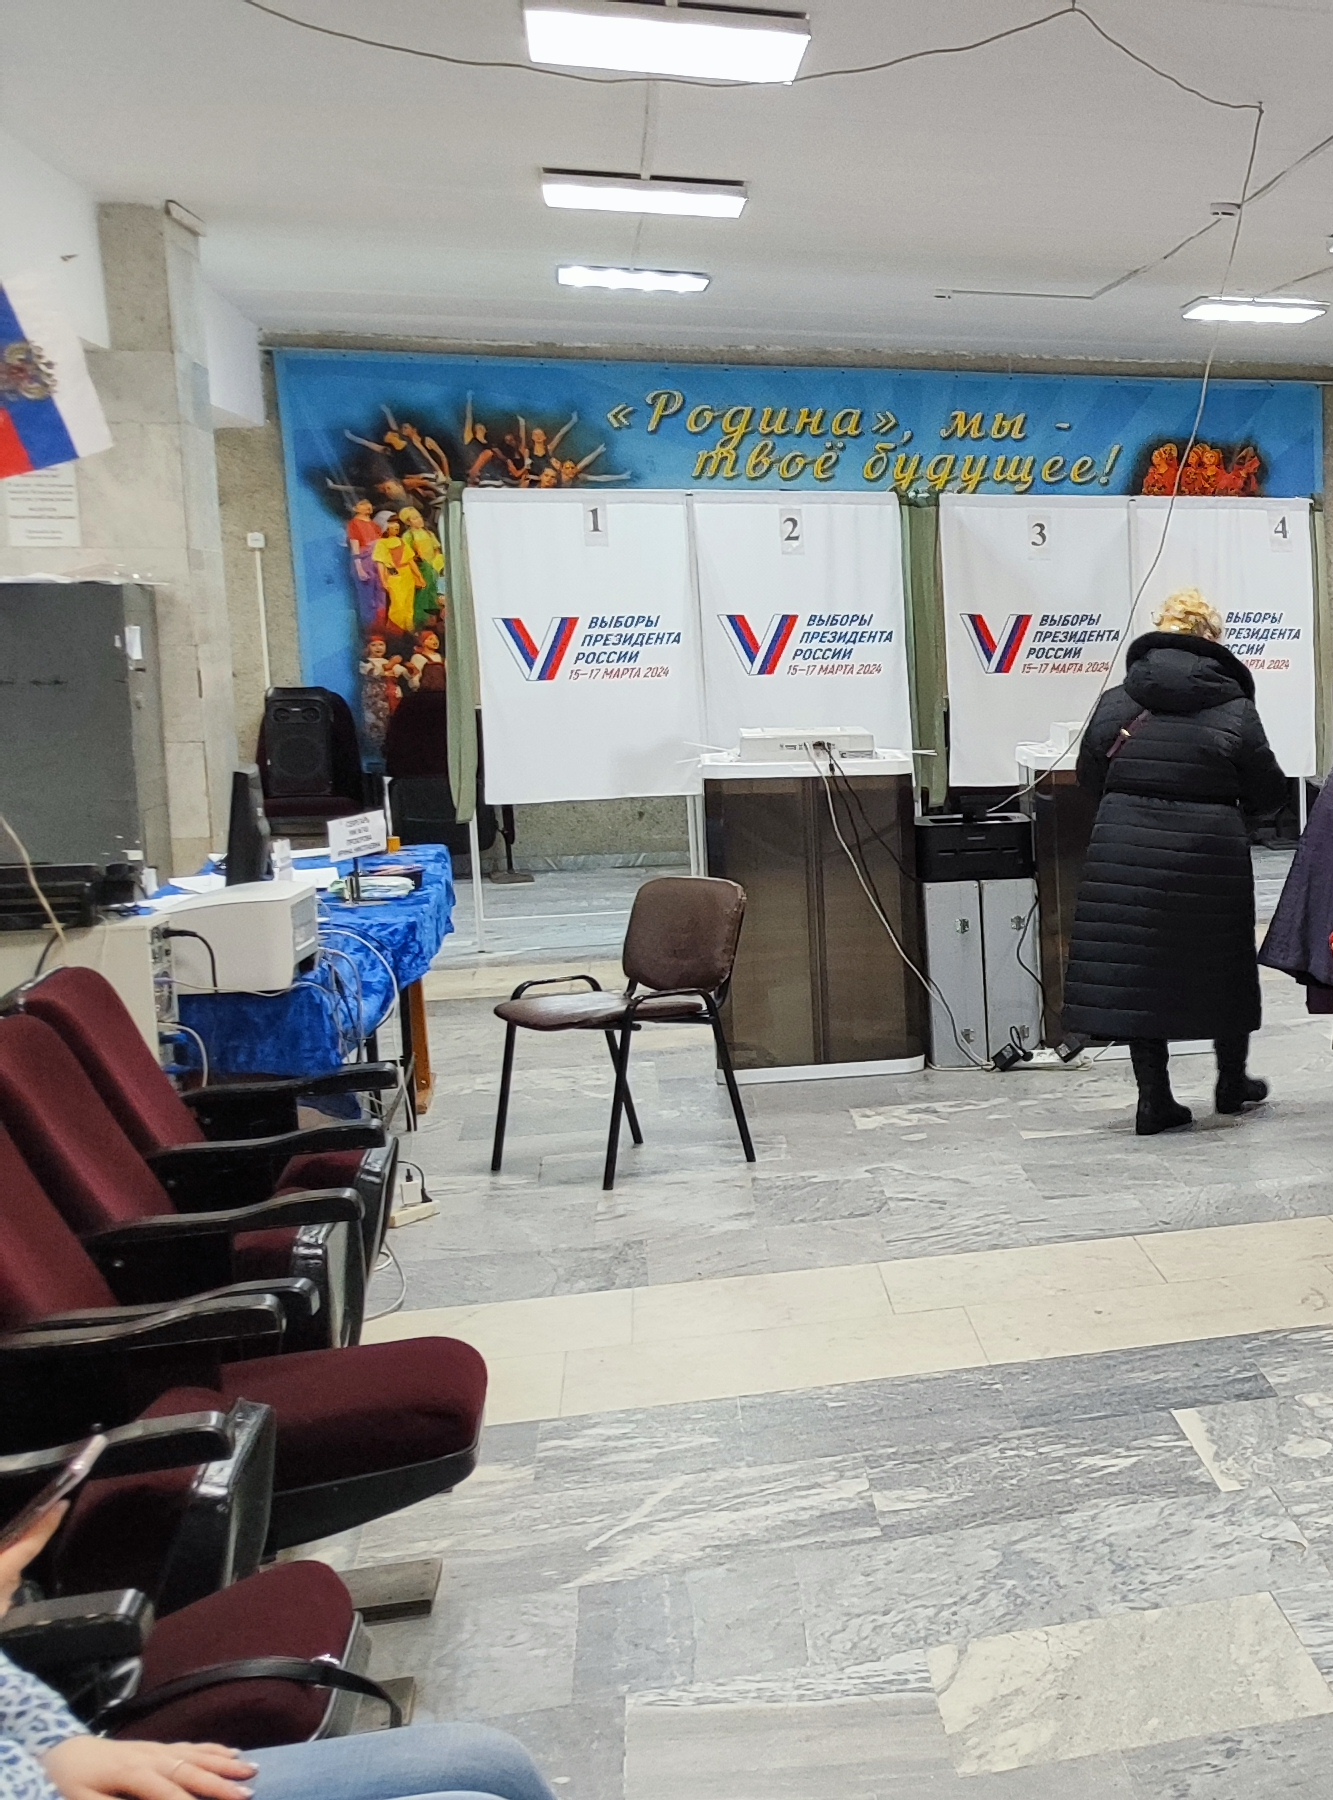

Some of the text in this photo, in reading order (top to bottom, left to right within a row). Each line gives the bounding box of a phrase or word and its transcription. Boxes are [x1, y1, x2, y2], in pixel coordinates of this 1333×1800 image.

[940, 409, 1029, 441] мы
[692, 440, 1124, 492] твоё будущее!
[587, 507, 603, 533] 1
[782, 517, 801, 542] 2
[1031, 522, 1047, 547] 3
[1273, 516, 1290, 539] 4
[587, 615, 661, 630] ВЫБОРЫ
[806, 614, 874, 627] ВЫБОРЫ
[1039, 613, 1102, 627] ВЫБОРЫ
[1225, 611, 1284, 625] ВЫБОРЫ
[581, 632, 682, 648] ПРЕЗИДЕНТА
[799, 630, 894, 645] ПРЕЗИДЕНТА
[1032, 629, 1121, 644] ПРЕЗИДЕНТА
[573, 651, 640, 665] РОССИИ
[792, 648, 853, 661] РОССИИ
[1026, 647, 1083, 660] РОССИИ
[817, 664, 855, 675] МАРТА
[856, 663, 882, 675] 2024
[1050, 662, 1084, 674] МАРТА
[1085, 662, 1110, 673] 2024
[1266, 659, 1290, 670] 2024
[601, 667, 642, 680] МАРТА
[643, 666, 670, 679] 2024
